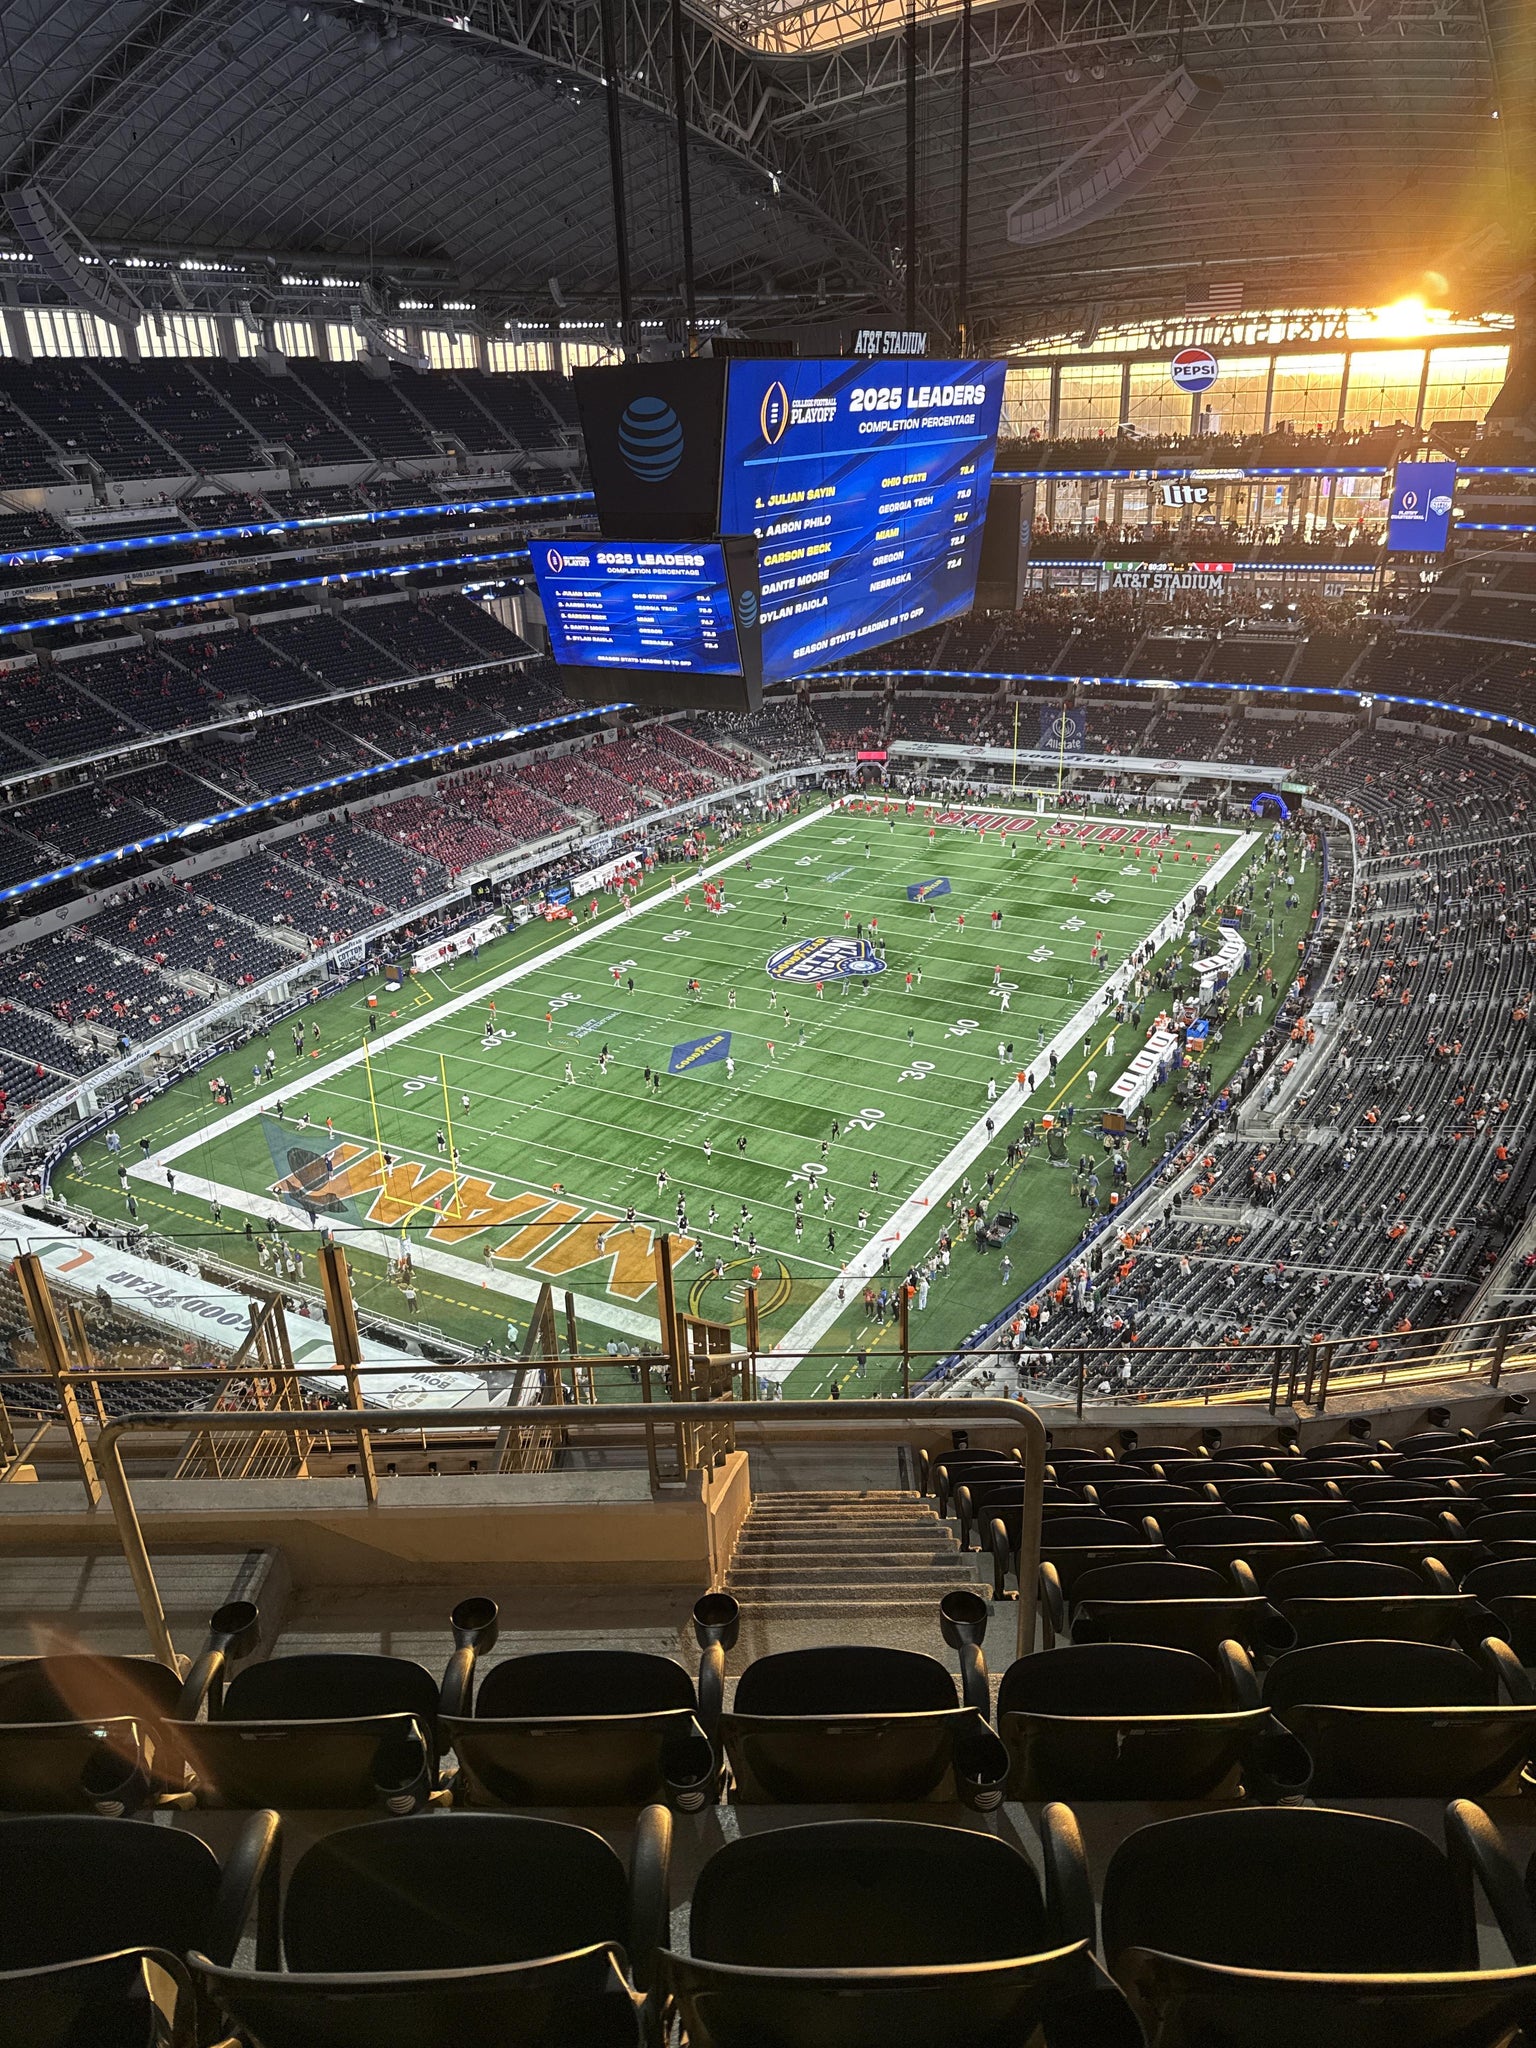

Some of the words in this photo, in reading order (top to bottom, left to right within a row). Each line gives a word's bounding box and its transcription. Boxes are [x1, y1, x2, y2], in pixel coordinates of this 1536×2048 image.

[854, 330, 882, 354] AT&T
[883, 331, 927, 354] STADIUM
[1173, 365, 1215, 376] PEPSI
[792, 399, 814, 407] COLLEGE
[849, 388, 902, 412] 2025
[907, 385, 986, 407] LEADERS
[790, 407, 837, 424] PLAYOFF
[859, 418, 920, 434] COMPLETION
[921, 414, 976, 428] PERCENTAGE
[881, 475, 901, 488] OHIO
[902, 472, 928, 485] STATE
[755, 497, 765, 509] 1.
[768, 491, 806, 507] JULIAN
[806, 486, 836, 502] SAYIN
[878, 500, 912, 514] GEORGIA
[913, 496, 934, 508] TECH
[1161, 485, 1208, 508] Lite
[766, 520, 801, 537] AARON
[803, 515, 832, 530] PHILO
[875, 527, 899, 541] MIAMI
[596, 553, 633, 565] 2025
[636, 554, 705, 566] LEADERS
[763, 548, 806, 566] CARSON
[806, 542, 832, 558] BECK
[872, 551, 905, 566] OREGON
[606, 567, 652, 575] COMPLETION
[652, 568, 700, 576] PERCENTAGE
[761, 578, 796, 596] DANTE
[797, 569, 830, 587] MOORE
[869, 572, 912, 592] NEBRASKA
[1113, 573, 1151, 588] AT&T
[1153, 574, 1224, 589] STADIUM
[759, 606, 794, 624] DYLAN
[794, 596, 829, 614] RAIOLA
[793, 640, 828, 659] SEASON
[829, 631, 856, 647] STATS
[857, 620, 890, 638] LEADING
[889, 618, 899, 629] IN
[899, 613, 909, 625] TO
[909, 607, 924, 620] CFP
[1045, 738, 1081, 750] Allstate
[1017, 753, 1119, 764] GOODYEAR
[933, 811, 1039, 832] OHIO
[1044, 821, 1181, 847] STATE
[794, 855, 816, 866] 20
[1119, 866, 1141, 876] 10
[754, 878, 780, 889] 30
[1089, 890, 1116, 905] 20
[1060, 917, 1087, 932] 30
[662, 928, 692, 943] 50
[772, 938, 826, 974] GOODYEAR
[784, 939, 858, 979] COTTON
[1026, 948, 1055, 963] 40
[608, 958, 638, 973] 40
[988, 982, 1019, 997] 50
[549, 992, 582, 1008] 30
[948, 1019, 980, 1037] 40
[480, 1029, 517, 1046] 20
[674, 1035, 725, 1071] GOODYEAR
[901, 1061, 936, 1080] 30
[402, 1075, 439, 1091] 10
[848, 1108, 886, 1131] 20
[791, 1162, 829, 1182] 10
[267, 1142, 697, 1302] MIAMI
[105, 1270, 252, 1332] GOODYEAR
